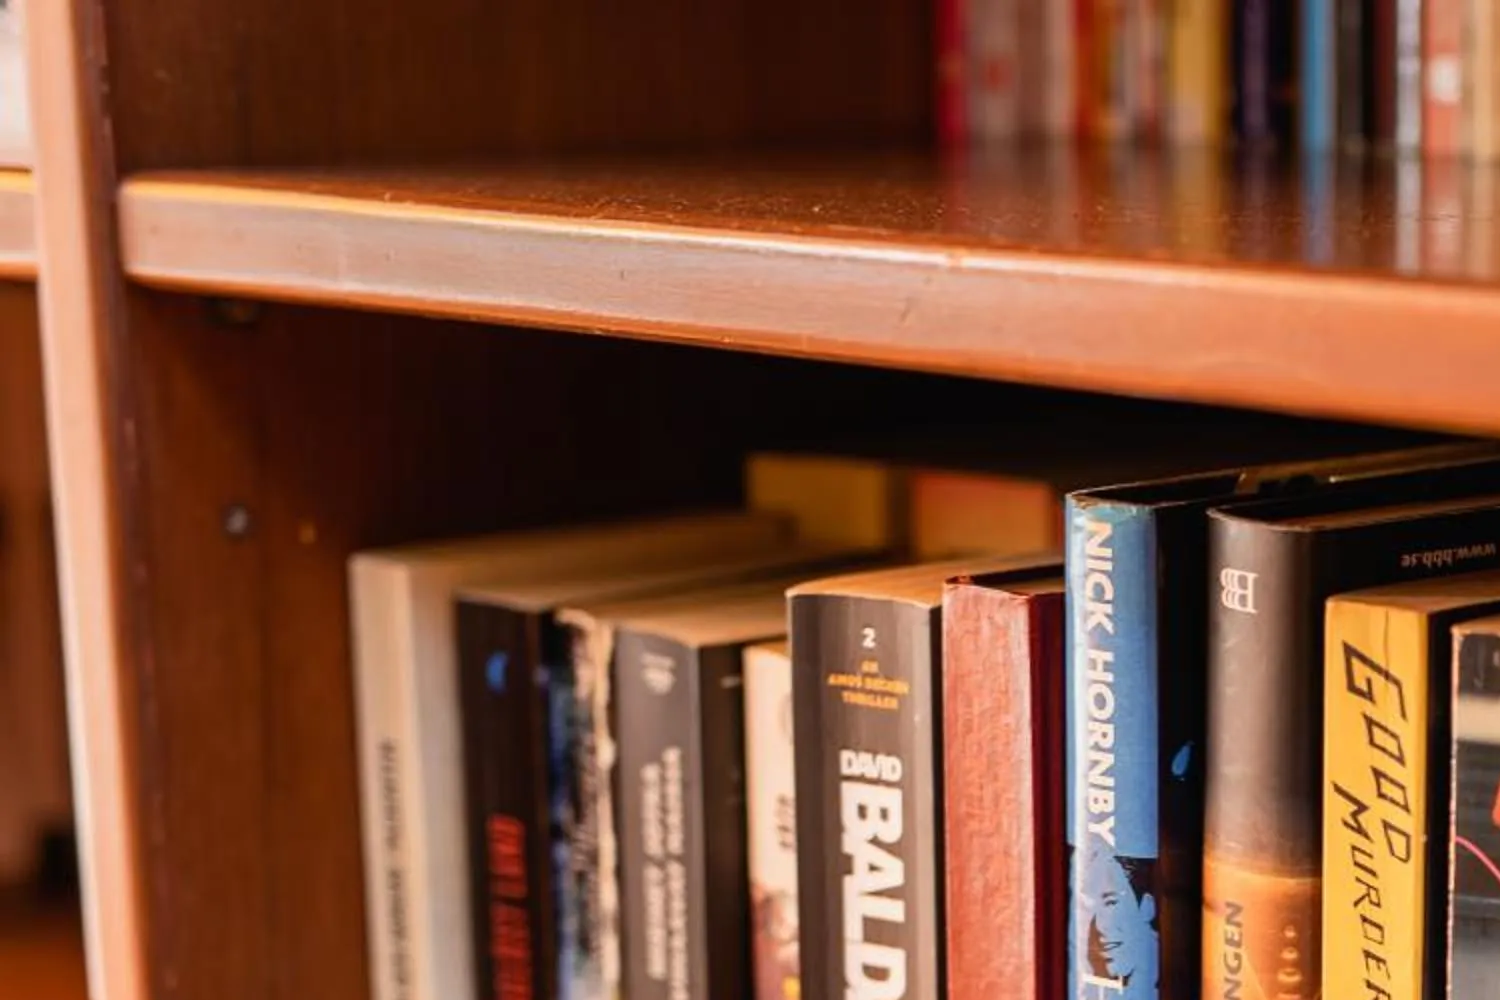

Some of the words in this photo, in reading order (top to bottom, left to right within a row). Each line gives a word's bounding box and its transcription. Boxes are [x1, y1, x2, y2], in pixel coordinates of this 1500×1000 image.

[1084, 519, 1114, 635] NICK
[861, 627, 877, 648] 2
[838, 749, 903, 782] DAVID
[1085, 650, 1116, 848] HORNBY
[1342, 639, 1414, 866] GOOD
